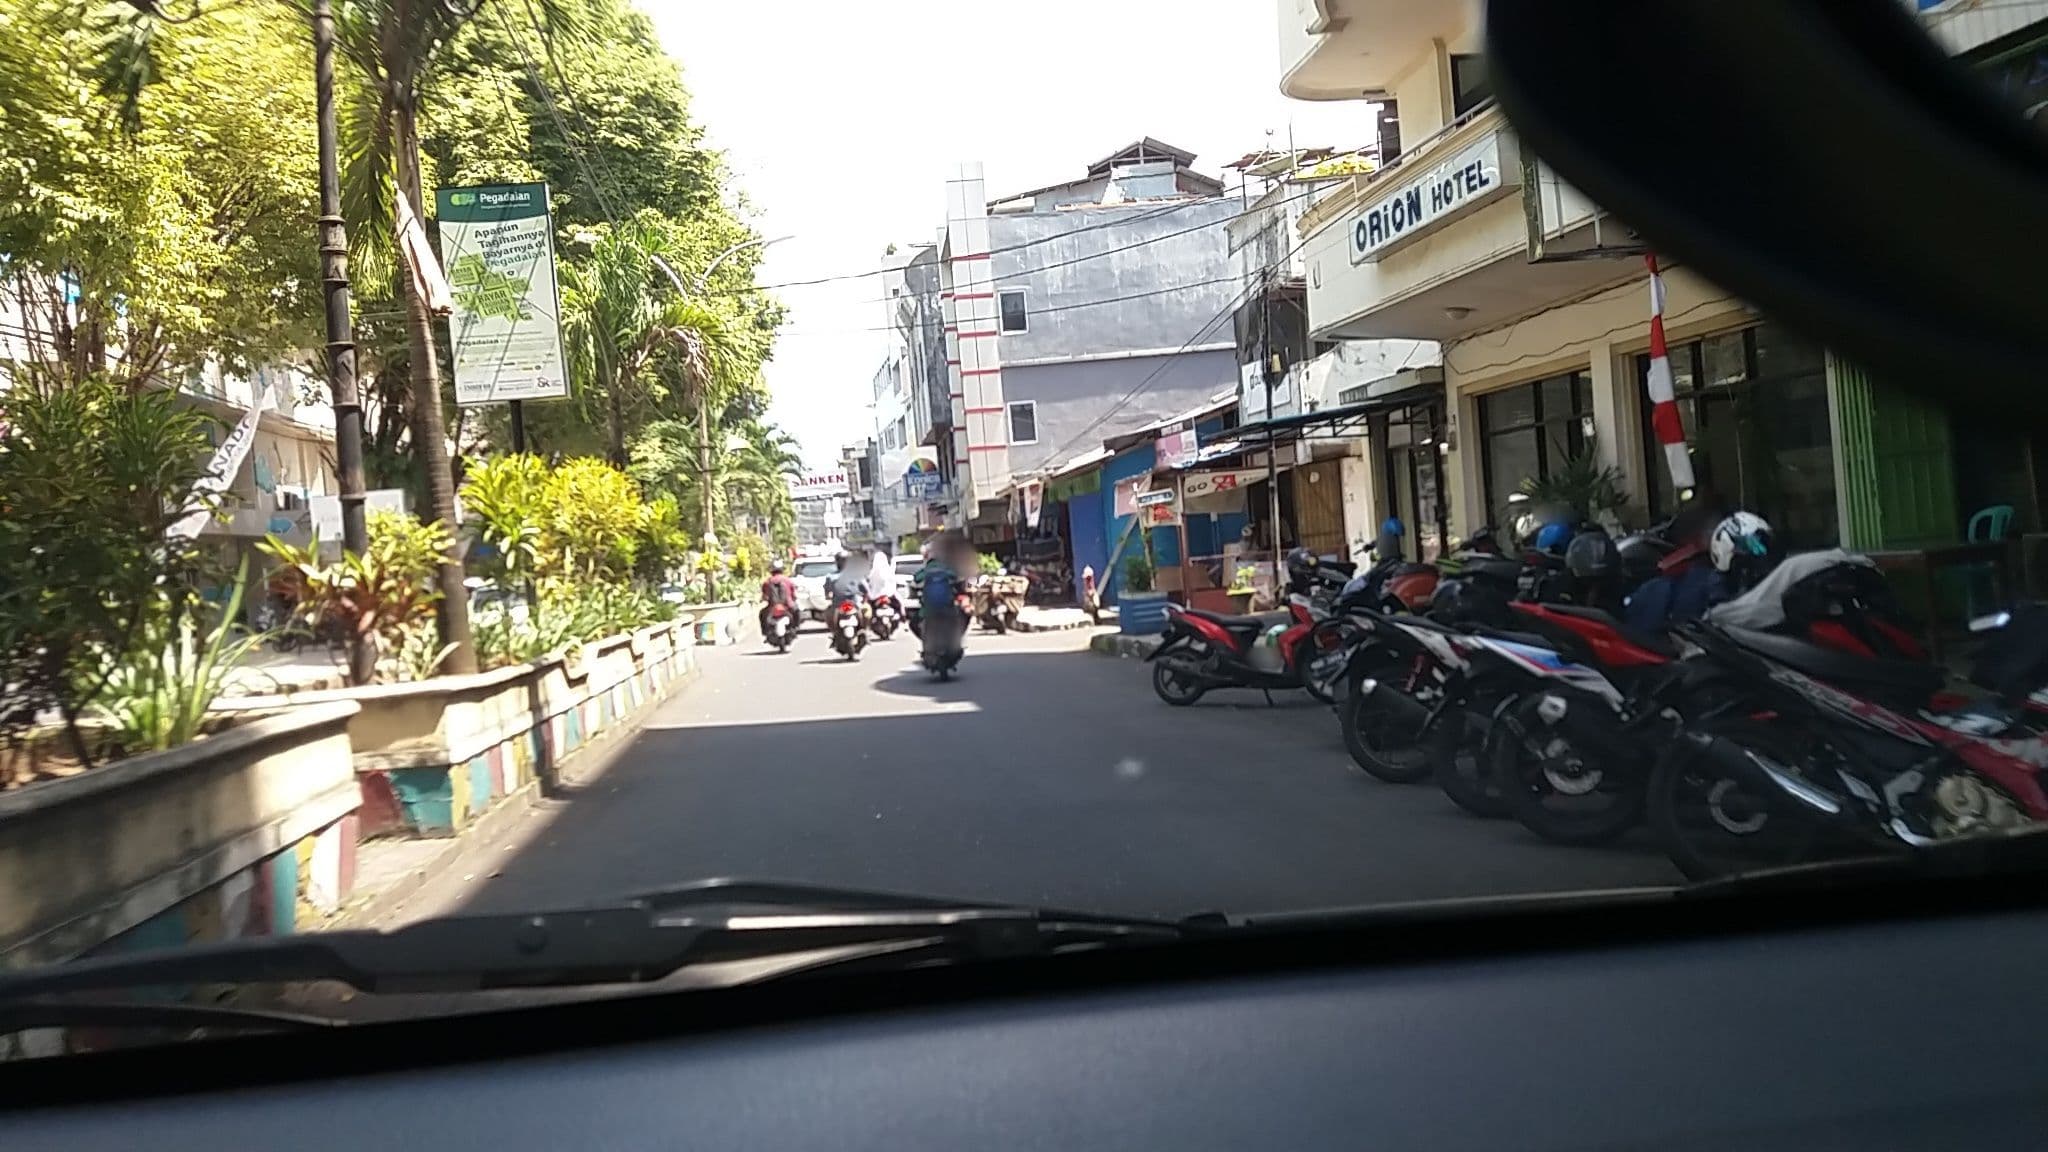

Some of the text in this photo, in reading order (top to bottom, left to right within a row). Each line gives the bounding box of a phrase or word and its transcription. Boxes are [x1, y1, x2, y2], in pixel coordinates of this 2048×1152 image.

[1431, 159, 1490, 214] HOTEL
[479, 191, 531, 204] Pegadaian
[474, 223, 519, 239] Apapun
[477, 230, 545, 250] Tagihannya
[482, 242, 534, 259] Bayarnya
[485, 250, 547, 268] Pegadaian
[478, 290, 507, 303] BAYAR
